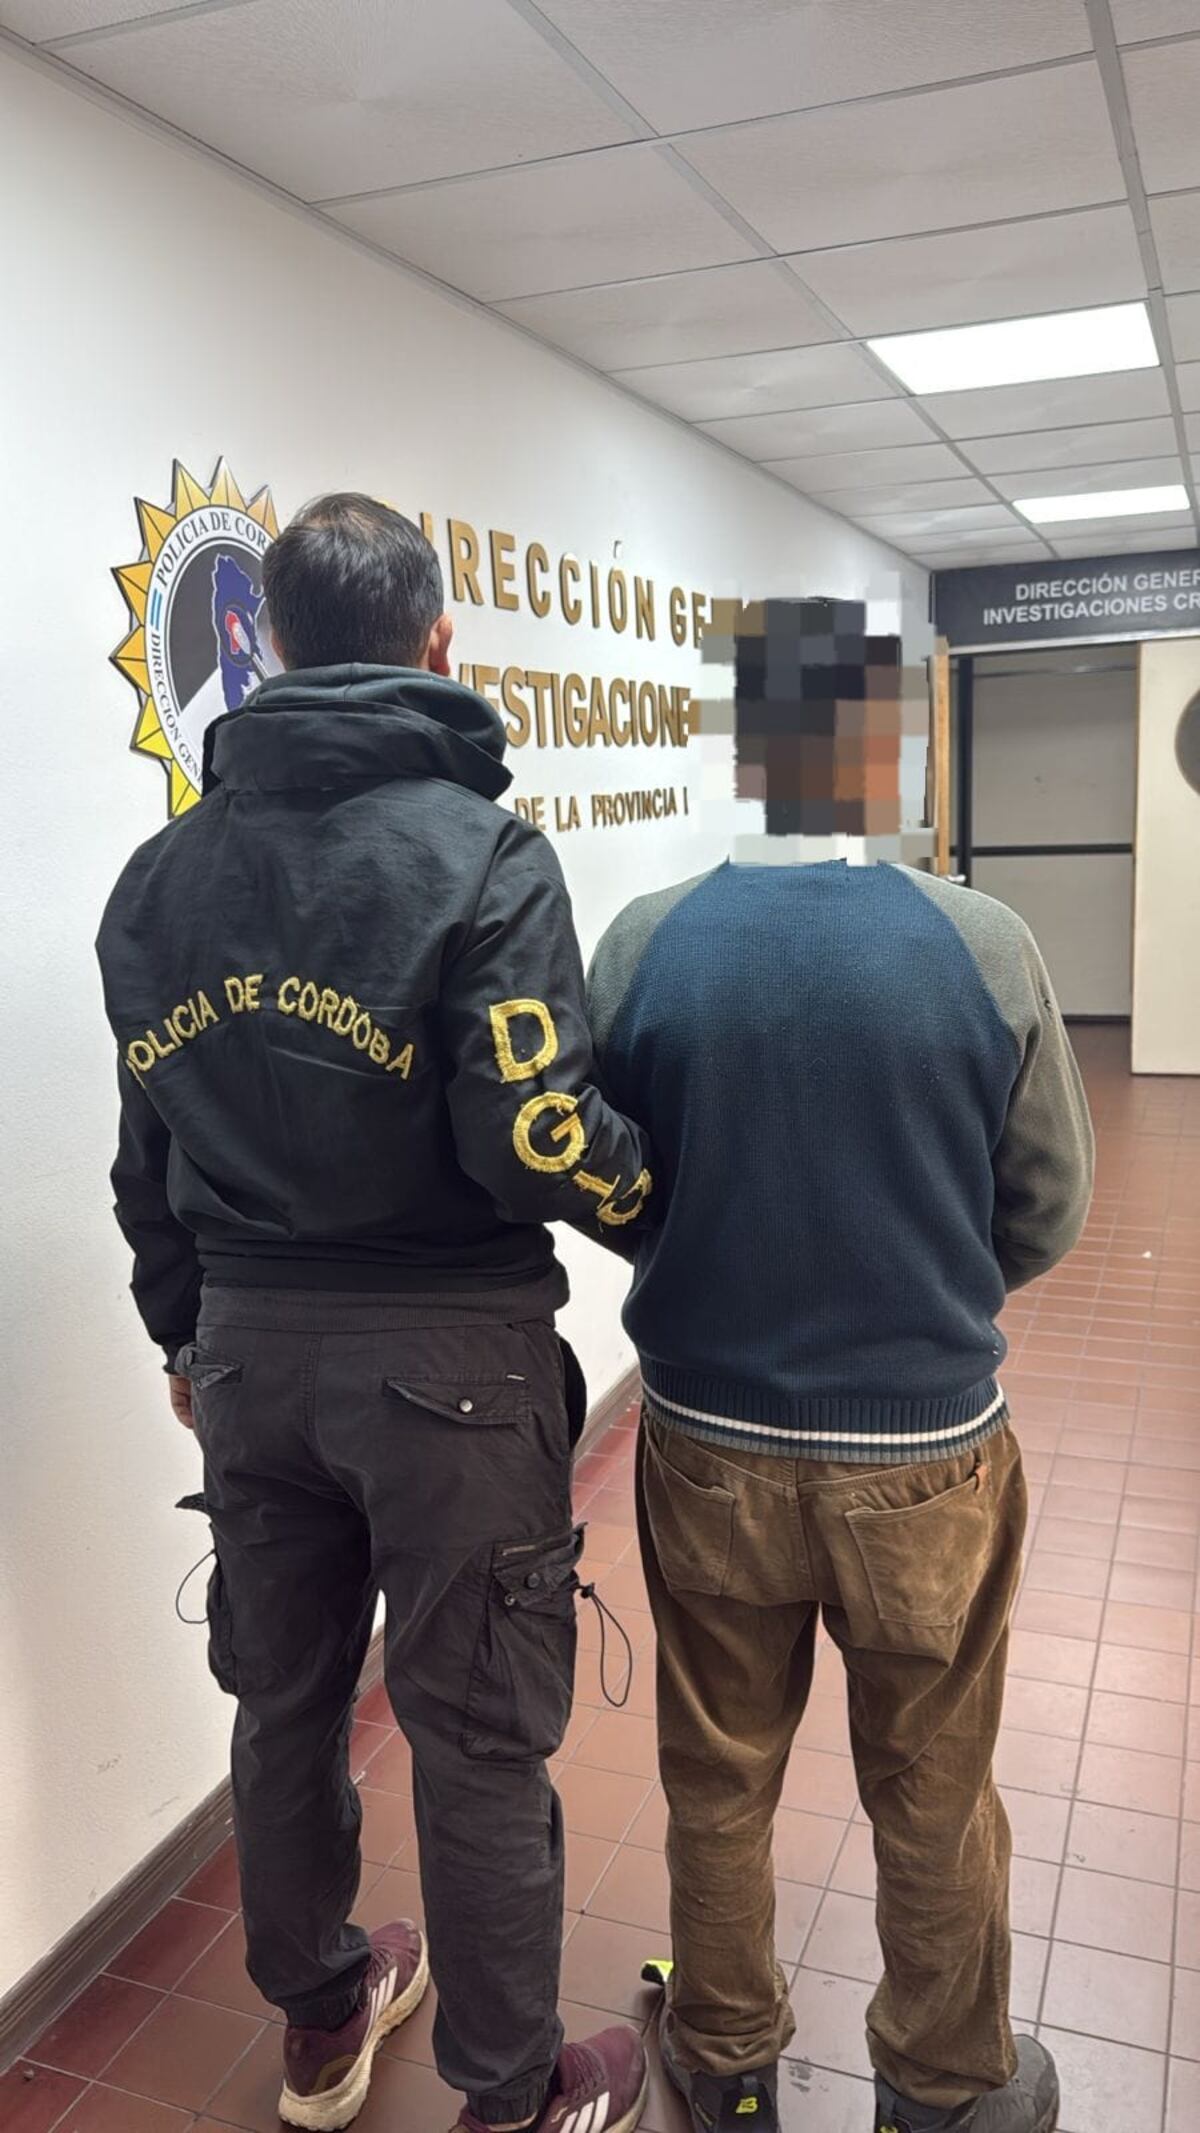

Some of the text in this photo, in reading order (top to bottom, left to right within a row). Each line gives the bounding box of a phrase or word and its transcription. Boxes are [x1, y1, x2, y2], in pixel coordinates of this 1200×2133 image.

[156, 511, 270, 588] POLICIA DE COR
[983, 594, 1167, 625] INVESTIGACIONES
[1015, 572, 1127, 601] DIRECCIÓN
[152, 631, 202, 783] DIRECCION GEN
[554, 795, 582, 833] LA
[591, 786, 677, 828] PROVINCIA
[125, 974, 415, 1090] OLICIA DE CORDOBA
